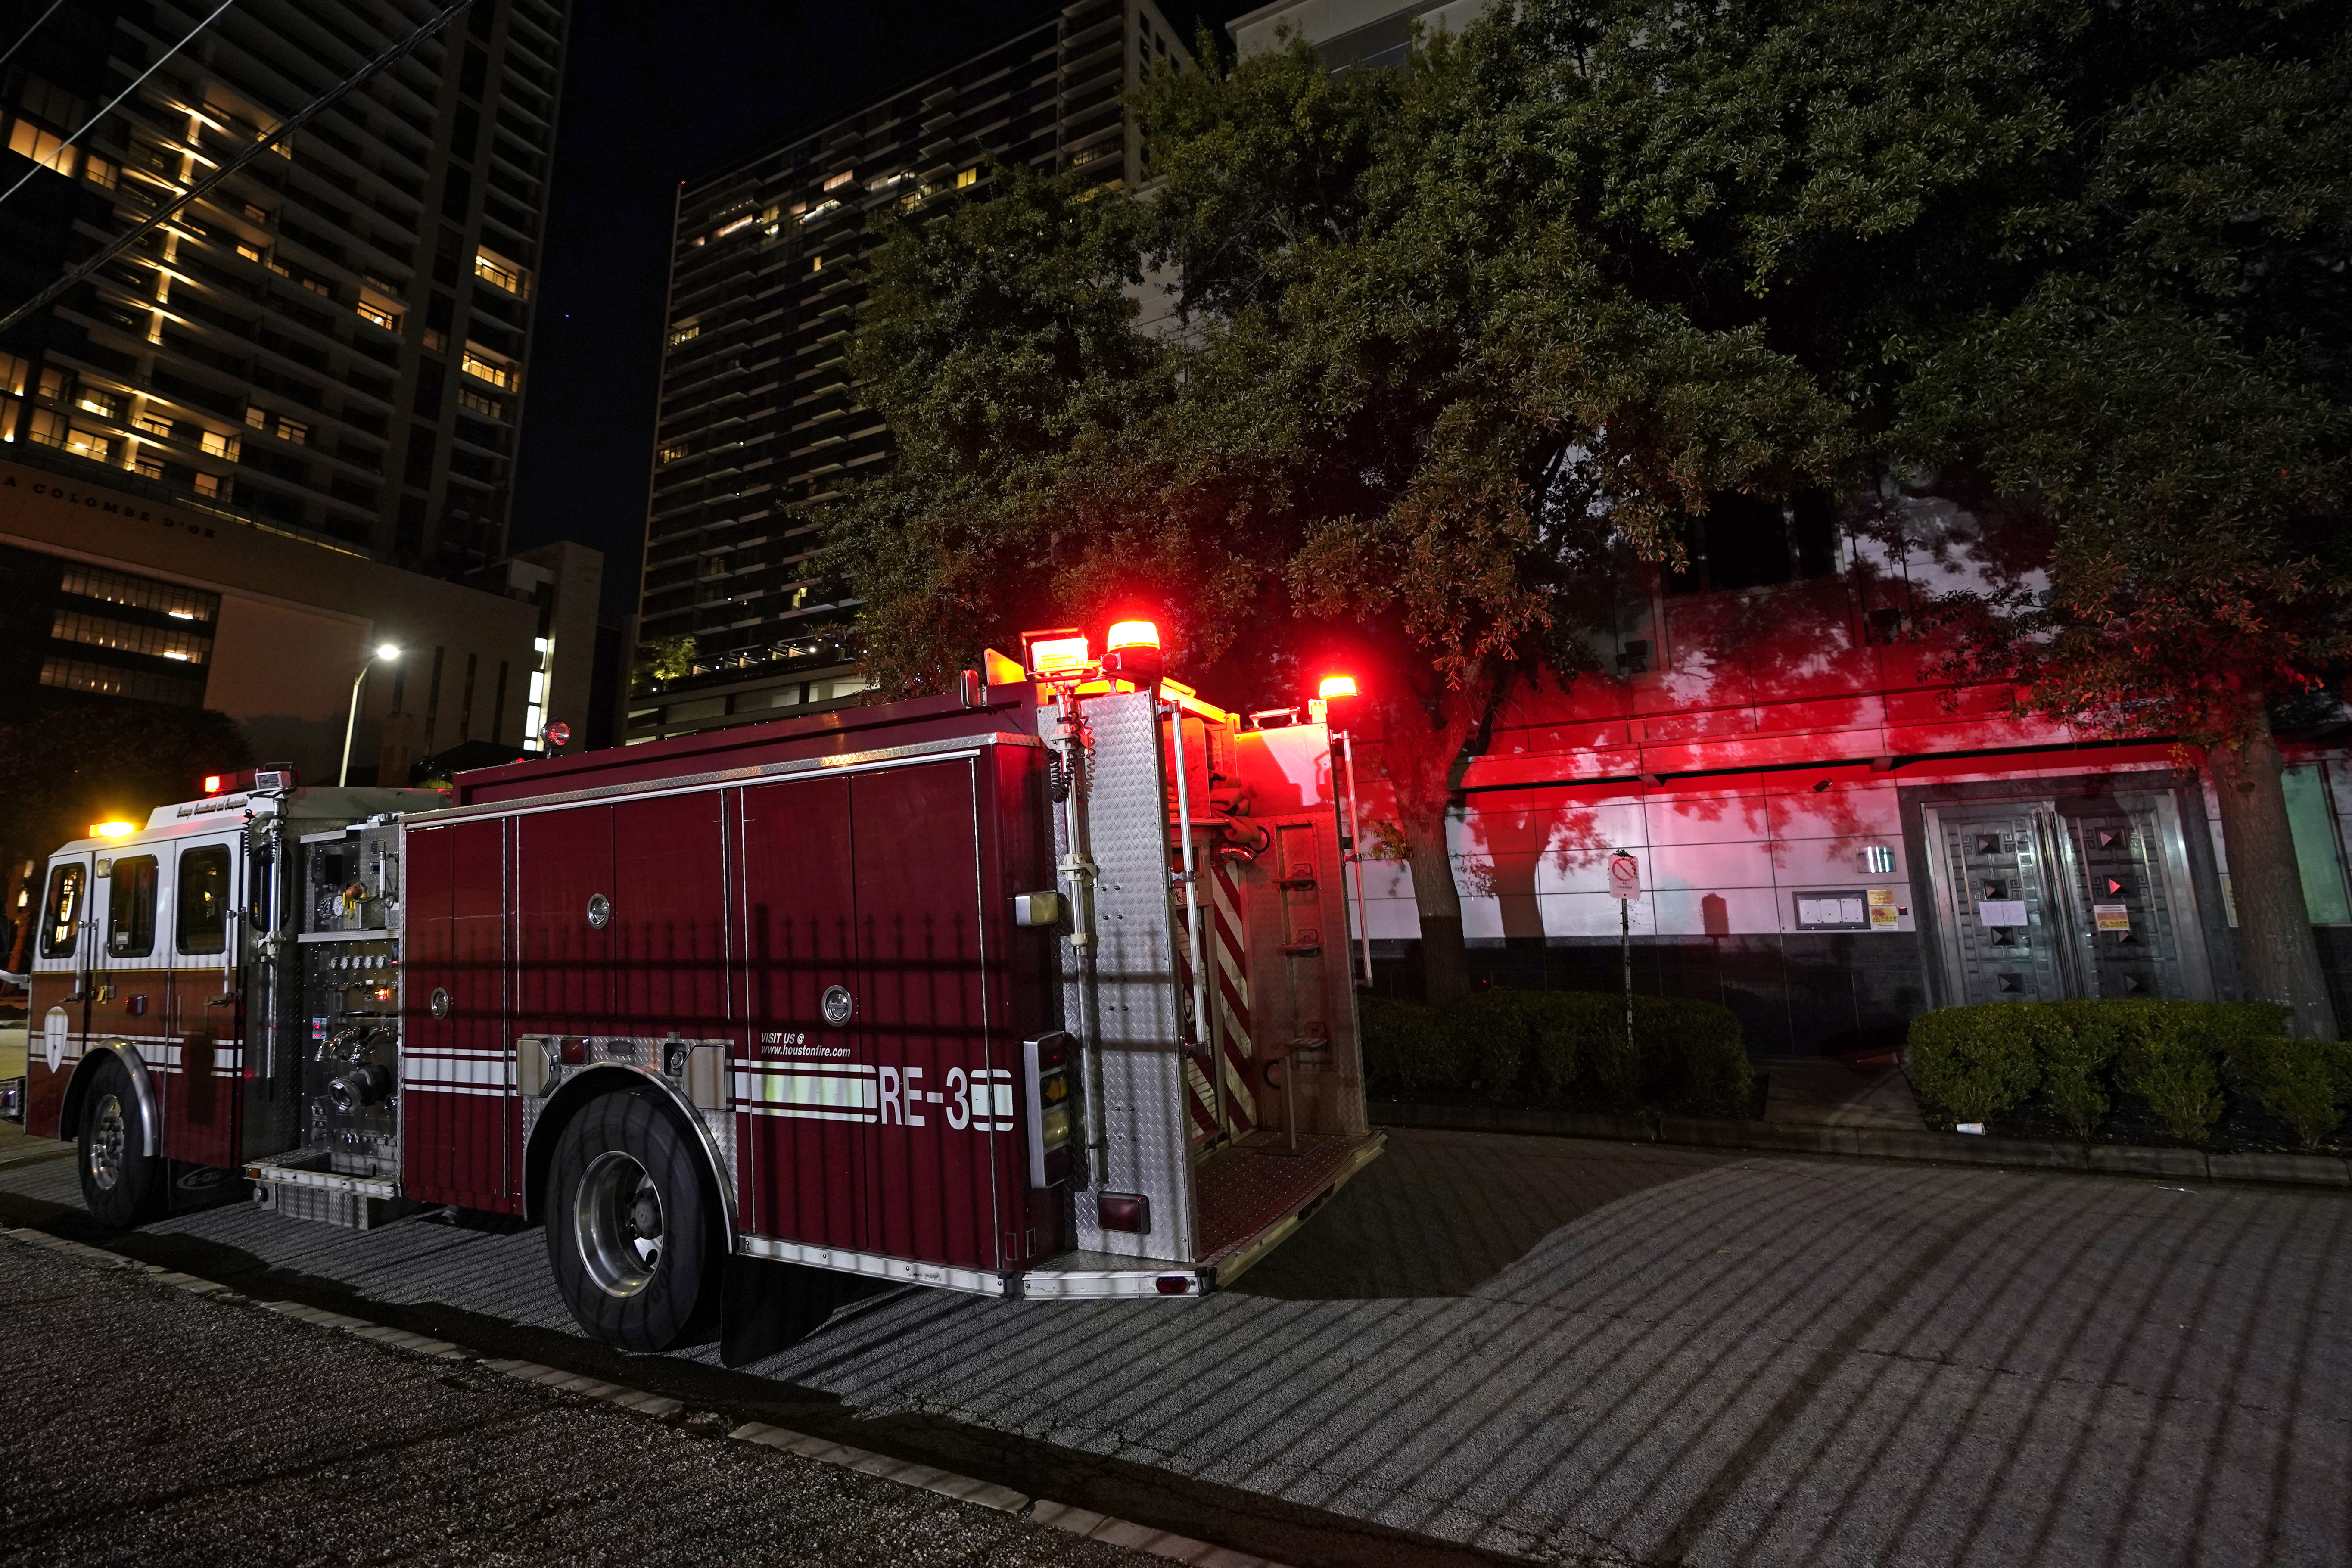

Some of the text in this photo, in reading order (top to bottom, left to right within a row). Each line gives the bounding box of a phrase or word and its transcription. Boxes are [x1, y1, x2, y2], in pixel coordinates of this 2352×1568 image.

[33, 483, 151, 522] COLOMBE
[761, 1033, 805, 1045] VISIT US @
[761, 1044, 851, 1057] www.houstonfire.com
[879, 1066, 970, 1130] RE-3
